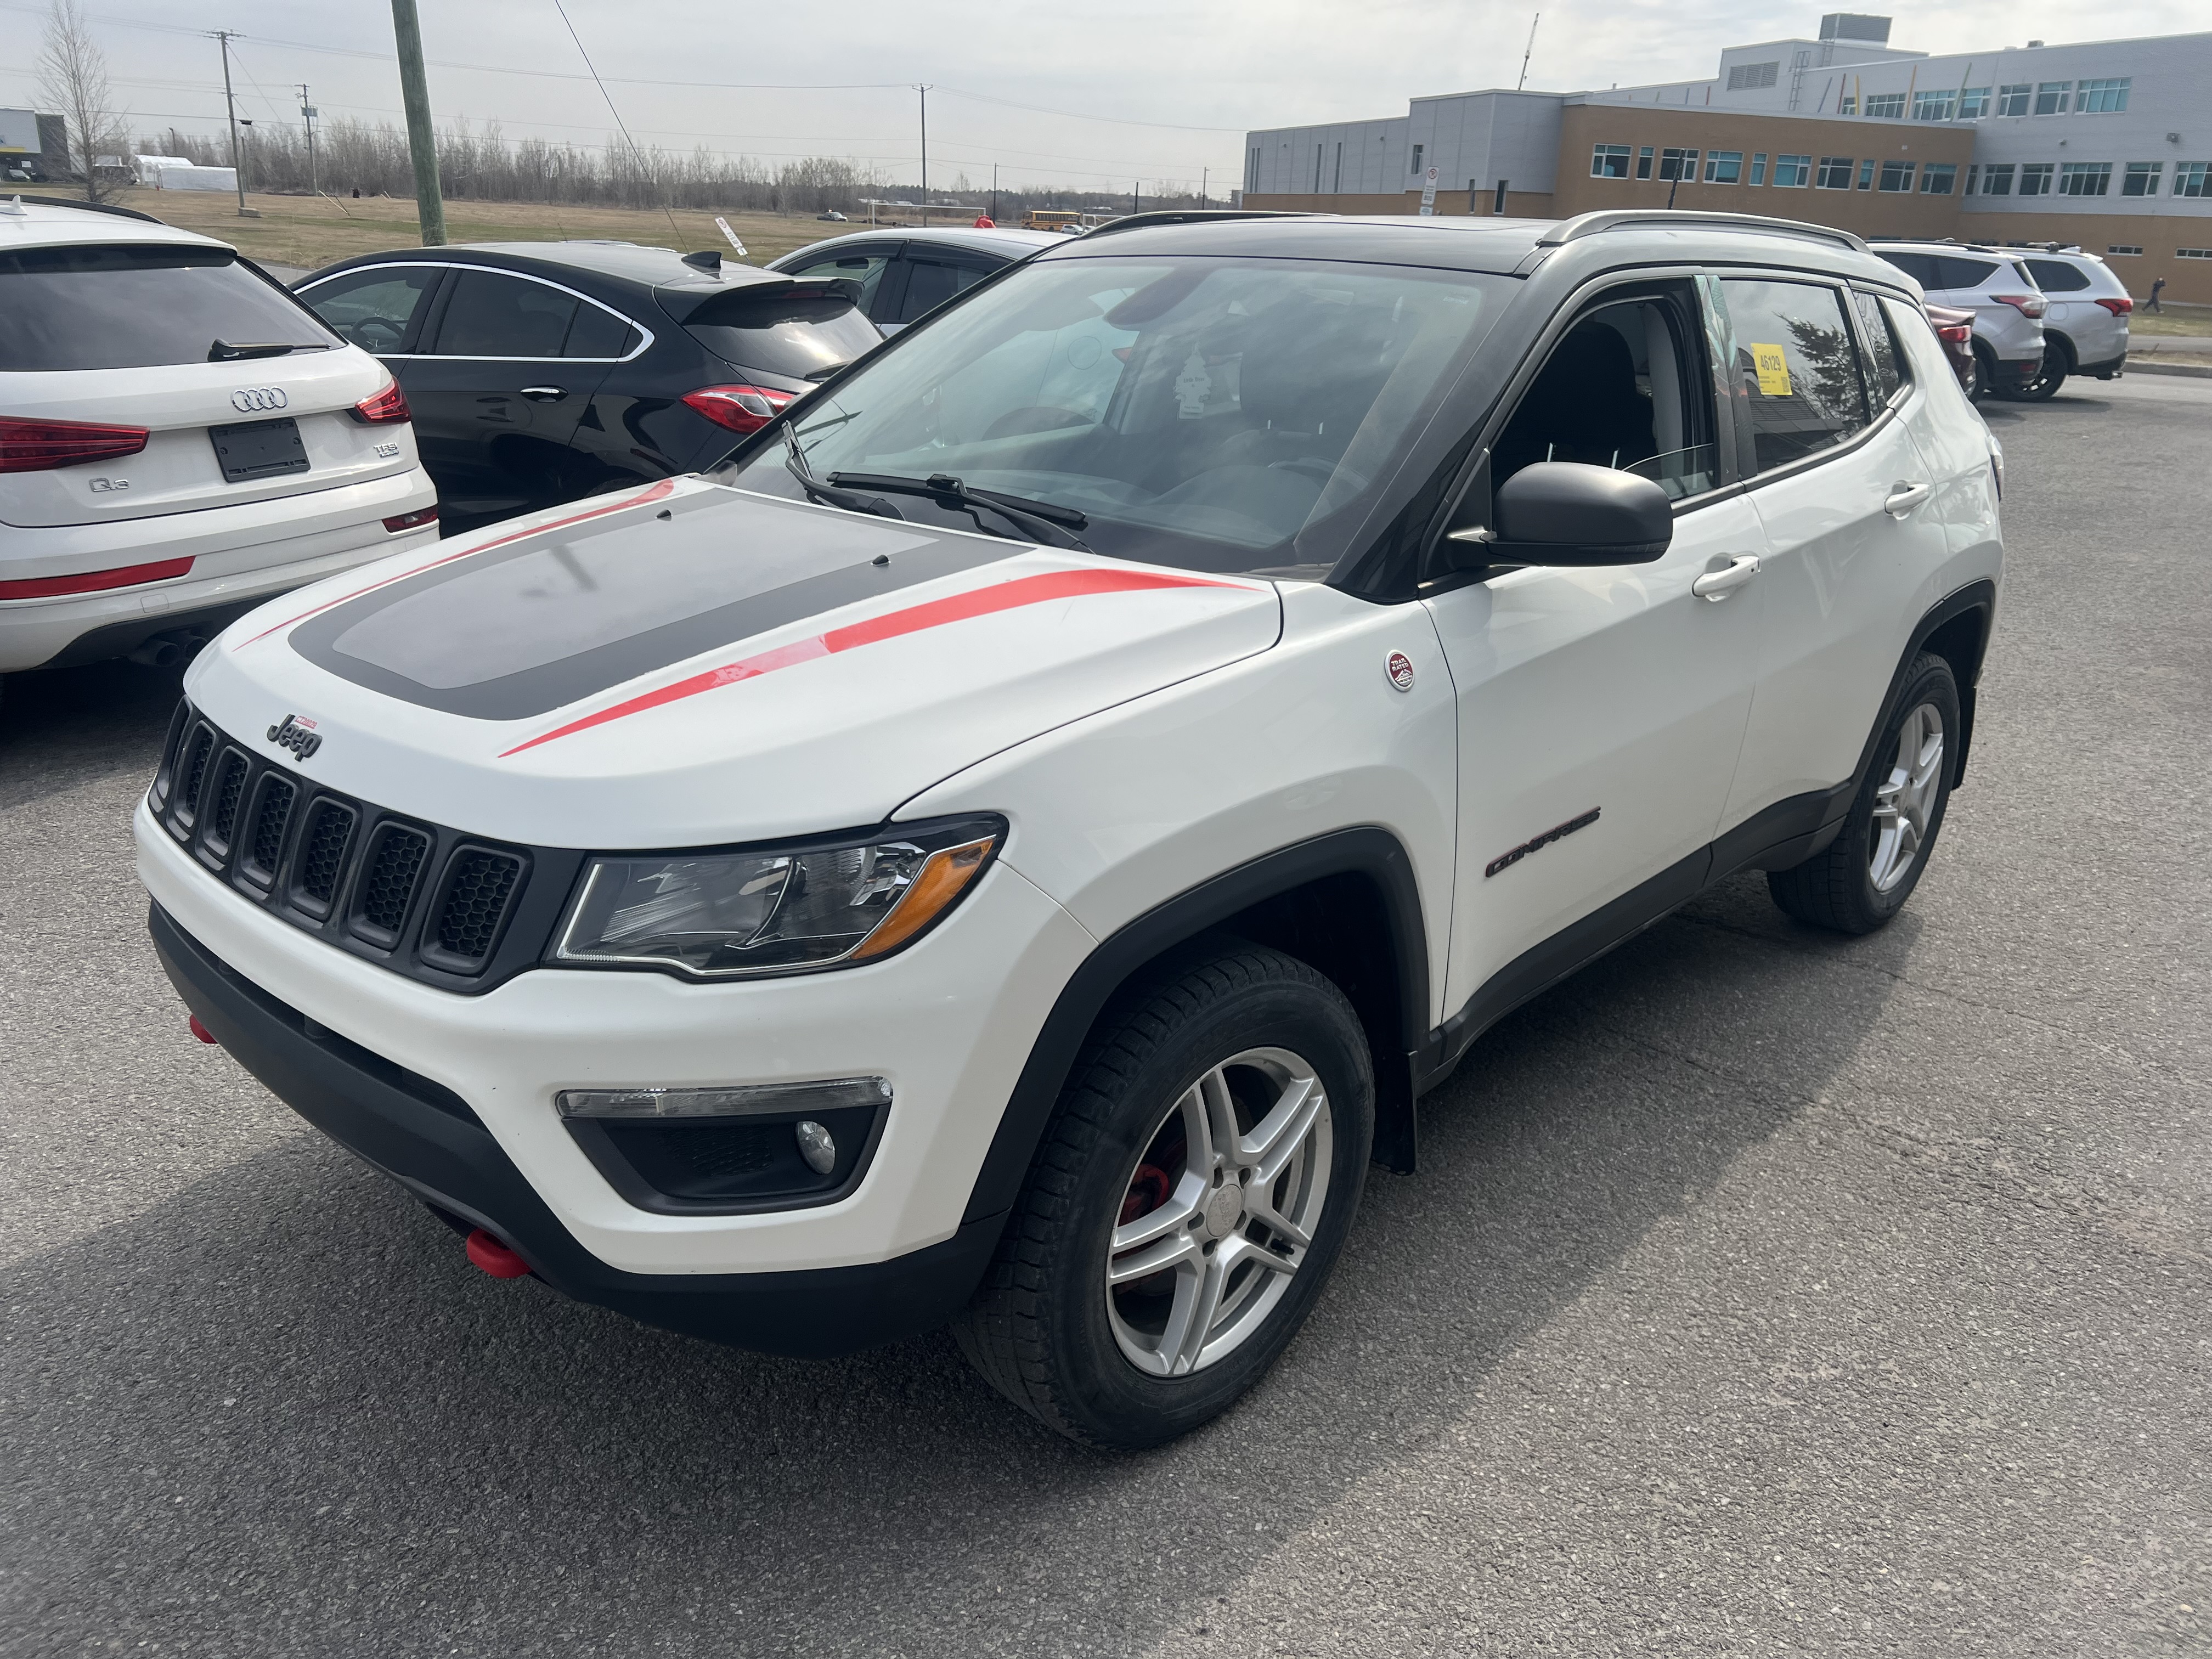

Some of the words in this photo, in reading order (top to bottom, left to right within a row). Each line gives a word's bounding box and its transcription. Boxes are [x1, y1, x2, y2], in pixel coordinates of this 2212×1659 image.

[1760, 355, 1781, 371] 46129
[373, 442, 398, 453] TFSI
[89, 478, 129, 492] Q3
[1391, 658, 1407, 666] TRAIL
[1392, 663, 1409, 672] RATED
[267, 714, 323, 763] Jeep
